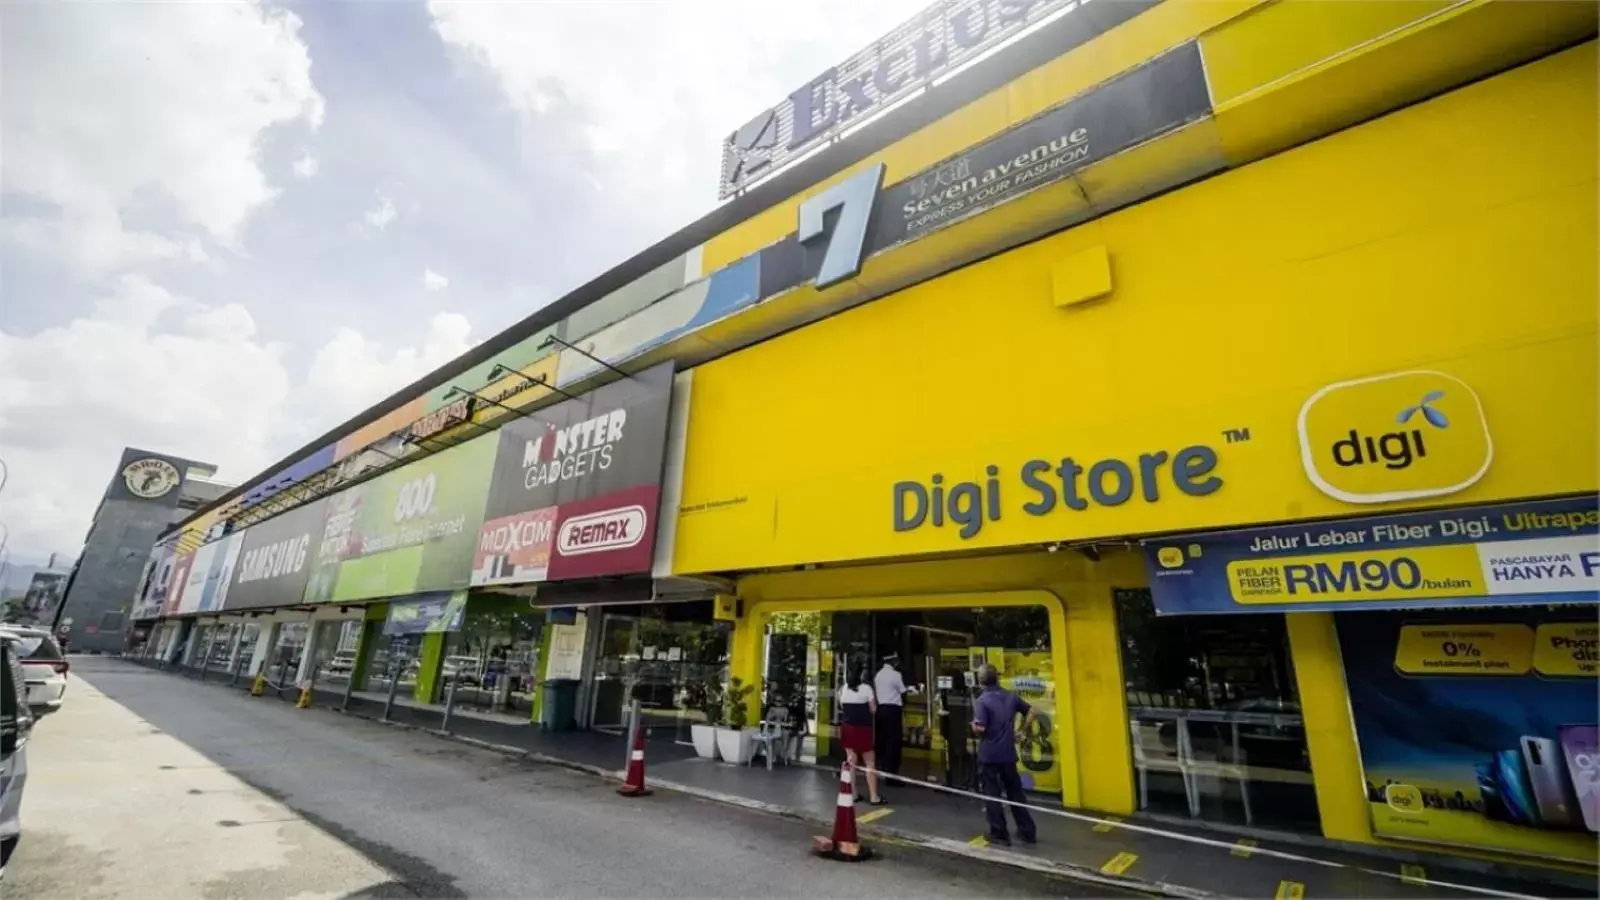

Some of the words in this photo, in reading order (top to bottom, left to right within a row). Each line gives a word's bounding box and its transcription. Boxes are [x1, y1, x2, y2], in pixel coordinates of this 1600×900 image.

[902, 178, 977, 220] Seven
[982, 126, 1088, 190] avenue
[906, 200, 965, 231] EXPRESS
[967, 180, 1010, 204] YOUR
[1014, 144, 1090, 188] FASHION
[799, 161, 887, 290] 7
[522, 408, 626, 467] MONSTER
[1332, 429, 1428, 471] digi
[524, 445, 613, 489] GADGETS
[893, 464, 1001, 540] Digi
[1021, 443, 1224, 517] Store
[1222, 428, 1251, 445] TM
[480, 520, 552, 553] MOXOM
[568, 518, 630, 547] REMAX
[1250, 536, 1299, 552] Jalur
[1305, 529, 1366, 547] Lebar
[1372, 523, 1433, 542] Fiber
[1440, 516, 1498, 538] Digi.
[239, 533, 310, 583] SAMSUNG
[1237, 567, 1279, 578] PELAN
[1284, 557, 1422, 594] RM90
[1491, 553, 1572, 565] PASCABAYAR
[1492, 565, 1576, 581] HANYA
[1239, 578, 1281, 589] FIBER
[1442, 642, 1480, 657] 0%
